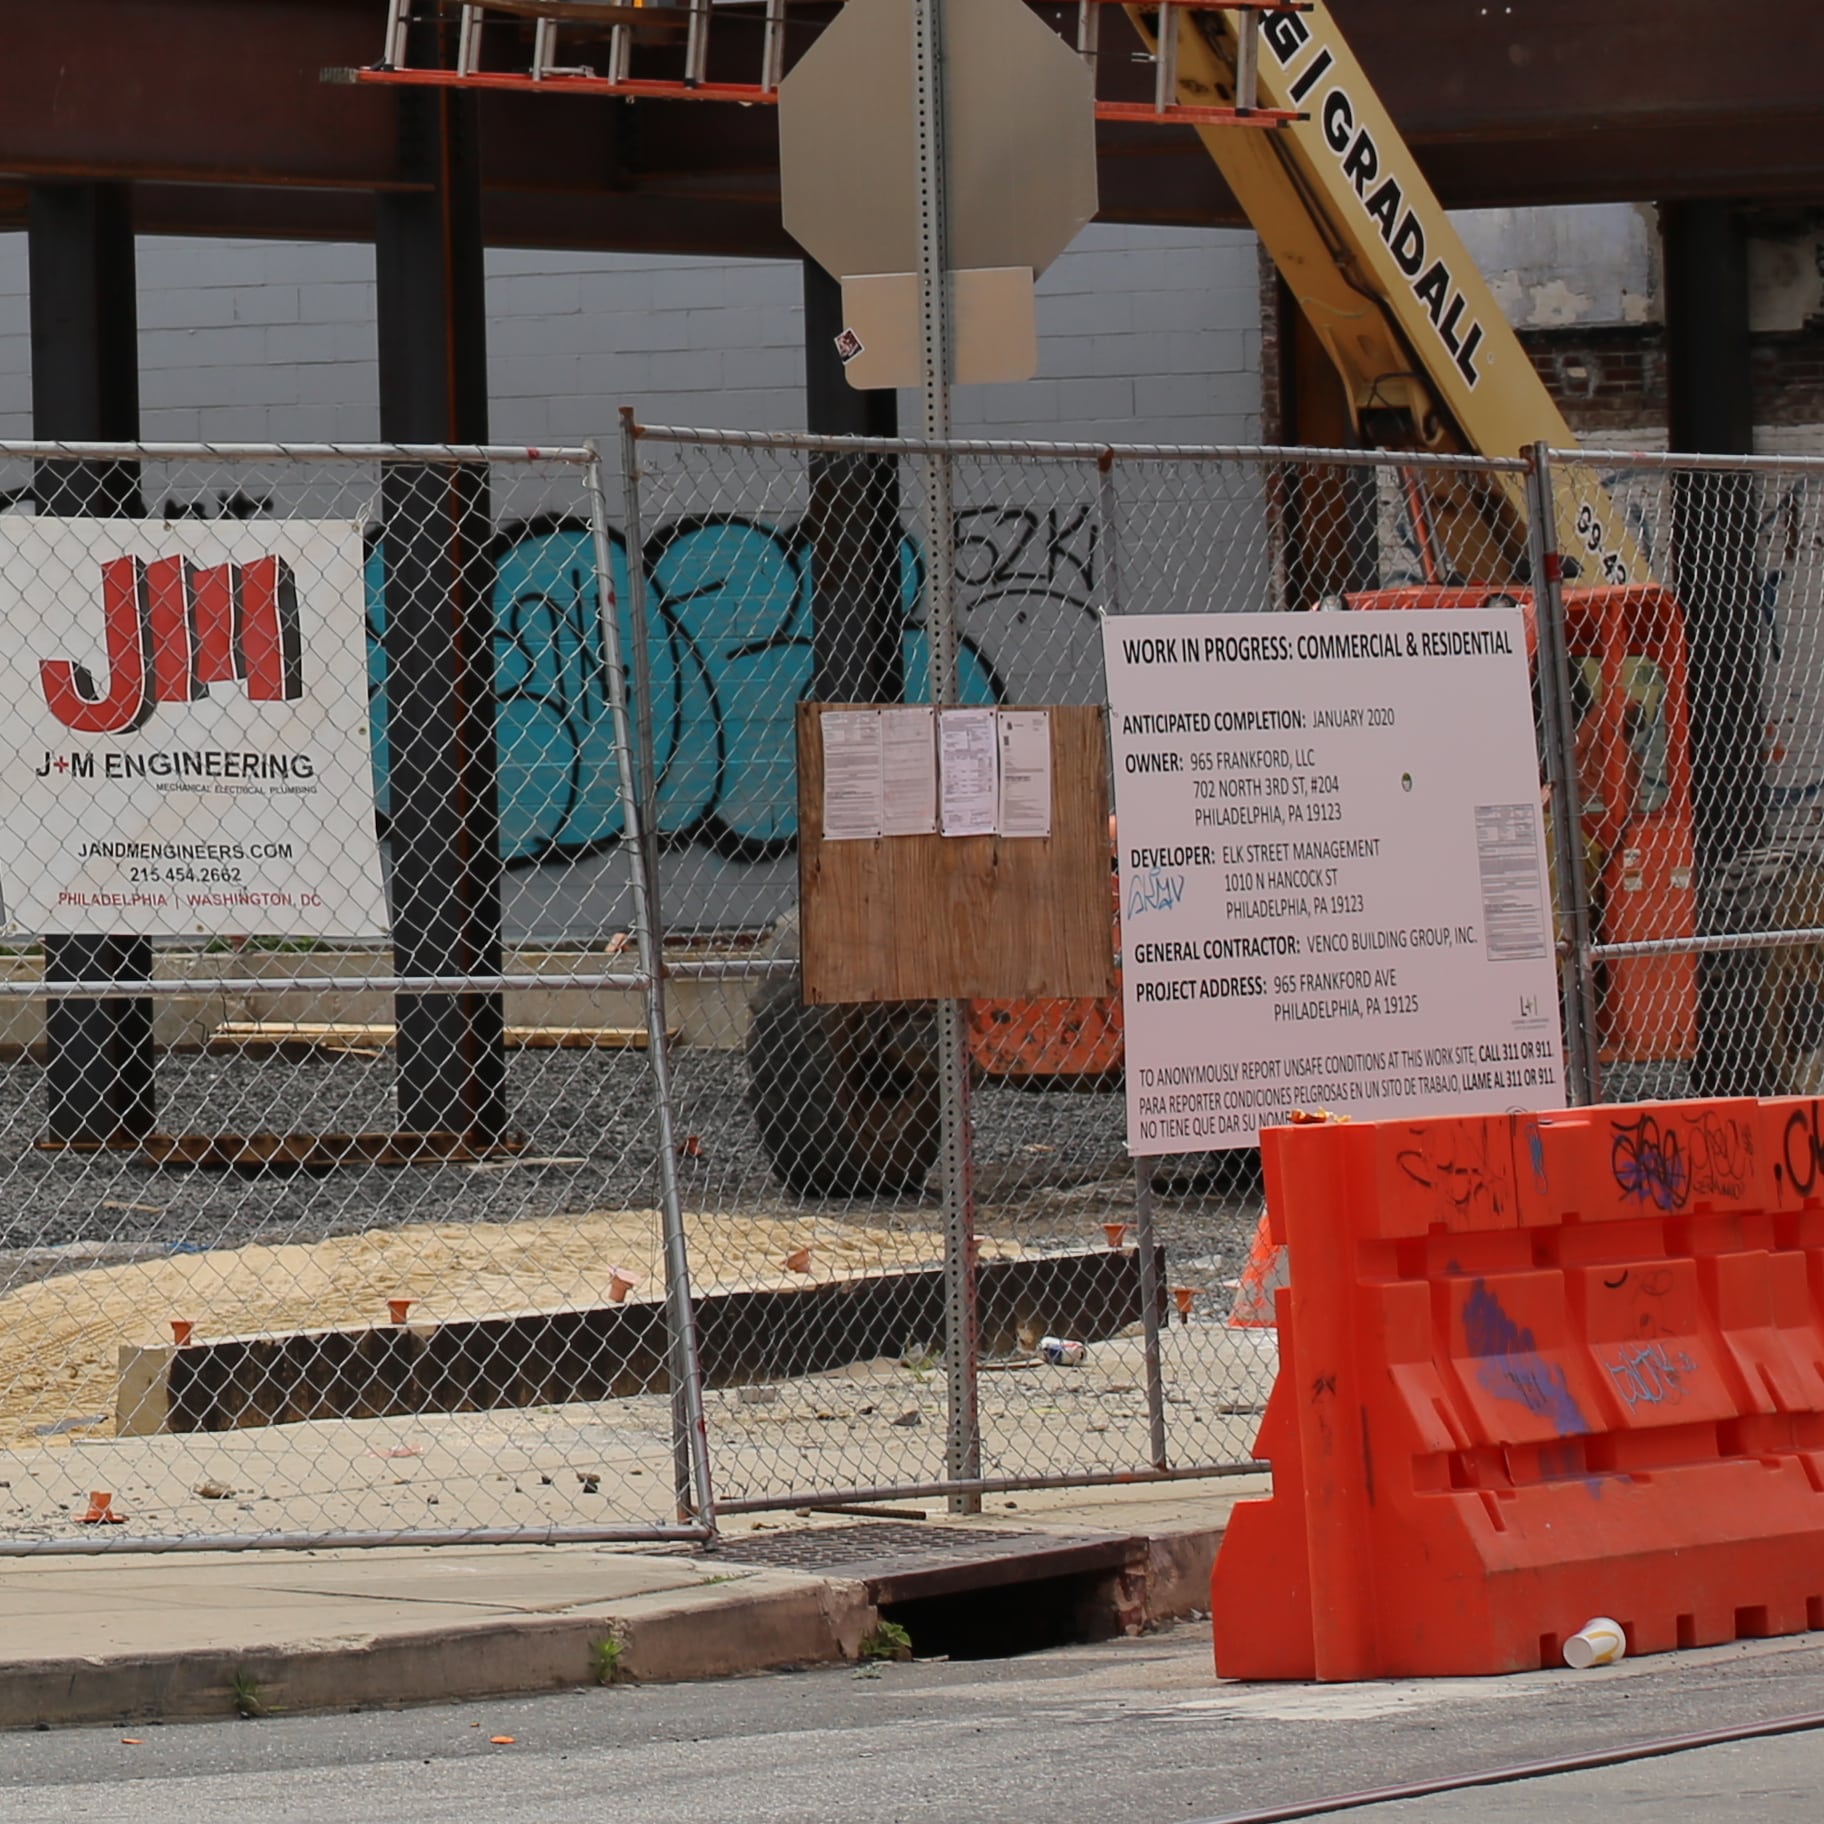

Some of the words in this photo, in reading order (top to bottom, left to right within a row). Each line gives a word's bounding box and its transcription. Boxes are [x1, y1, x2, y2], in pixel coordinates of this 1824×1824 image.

[1323, 90, 1484, 387] GRADALL
[1123, 638, 1177, 664] WORK
[1182, 638, 1199, 663] IN
[1205, 635, 1294, 662] PROGRESS:
[1297, 633, 1402, 660] COMMERCIAL
[1406, 632, 1418, 657] &
[1422, 630, 1512, 656] RESIDENTIAL
[1123, 713, 1210, 734] ANTICIPATED
[1214, 710, 1306, 731] COMPLETION:
[1312, 709, 1365, 728] JANUARY
[1367, 707, 1395, 726] 2020
[35, 751, 94, 778] J+M
[105, 751, 315, 779] ENGINEERING
[1125, 752, 1184, 773] OWNER:
[1190, 752, 1213, 771] 965
[1217, 749, 1292, 770] FRANKFORD,
[1295, 748, 1316, 767] LLC
[156, 783, 211, 794] MECHANICAL
[269, 785, 318, 795] PLUMBING
[1193, 780, 1215, 799] 702
[1219, 778, 1261, 798] NORTH
[1265, 777, 1289, 796] 3RD
[1292, 776, 1308, 796] ST,
[1311, 775, 1339, 793] #204
[1195, 805, 1285, 826] PHILADELPHIA,
[1288, 804, 1304, 822] PA
[1306, 802, 1342, 822] 19123
[78, 842, 293, 860] JANDMENGINEERS.COM
[1131, 845, 1215, 868] DEVELOPER:
[1222, 845, 1244, 864] ELK
[1247, 843, 1289, 862] STREET
[1293, 838, 1380, 860] MANAGEMENT
[1225, 873, 1253, 892] 1010
[1256, 872, 1265, 889] N
[1268, 869, 1323, 889] HANCOCK
[1325, 868, 1338, 886] ST
[58, 891, 168, 907] PHILADELPHIA
[186, 892, 297, 908] WASHINGTON,
[300, 894, 322, 907] DC
[1226, 898, 1311, 920] PHILADELPHIA,
[1314, 897, 1328, 914] PA
[1331, 894, 1364, 914] 19123
[1134, 941, 1200, 963] GENERAL
[1203, 936, 1300, 960] CONTRACTOR:
[1306, 933, 1348, 953] VENCO
[1352, 930, 1407, 950] BUILDING
[1410, 928, 1452, 948] GROUP,
[1455, 926, 1477, 944] INC.
[1136, 980, 1197, 1002] PROJECT
[1200, 976, 1267, 998] ADDRESS:
[1273, 975, 1296, 994] 965
[1300, 971, 1371, 992] FRANKFORD
[1375, 969, 1397, 987] AVE
[1274, 999, 1363, 1022] PHILADELPHIA,
[1366, 998, 1381, 1015] PA
[1384, 994, 1419, 1014] 19125
[1139, 1068, 1154, 1087] TO
[1157, 1062, 1239, 1086] ANONYMOUSLY
[1242, 1060, 1281, 1080] REPORT
[1284, 1056, 1323, 1077] UNSAFE
[1325, 1053, 1386, 1074] CONDITIONS
[1388, 1051, 1400, 1068] AT
[1401, 1049, 1422, 1068] THIS
[1424, 1047, 1453, 1066] WORK
[1456, 1046, 1477, 1066] SITE,
[1479, 1044, 1501, 1062] CALL
[1503, 1042, 1519, 1060] 311
[1521, 1041, 1534, 1058] OR
[1139, 1097, 1167, 1115] PARA
[1169, 1093, 1222, 1113] REPORTER
[1223, 1087, 1292, 1109] CONDICIONES
[1294, 1081, 1348, 1104] PELGROSAS
[1350, 1083, 1363, 1100] EN
[1365, 1082, 1379, 1098] UN
[1382, 1078, 1401, 1097] SITO
[1404, 1077, 1416, 1095] DE
[1418, 1074, 1461, 1094] TRABAJO,
[1462, 1071, 1492, 1091] LLAME
[1494, 1070, 1505, 1088] AL
[1506, 1069, 1522, 1087] 311
[1524, 1068, 1537, 1086] OR
[1140, 1121, 1157, 1140] NO
[1160, 1118, 1190, 1138] TIENE
[1192, 1116, 1215, 1137] QUE
[1219, 1114, 1241, 1134] DAR
[1243, 1113, 1256, 1132] SU
